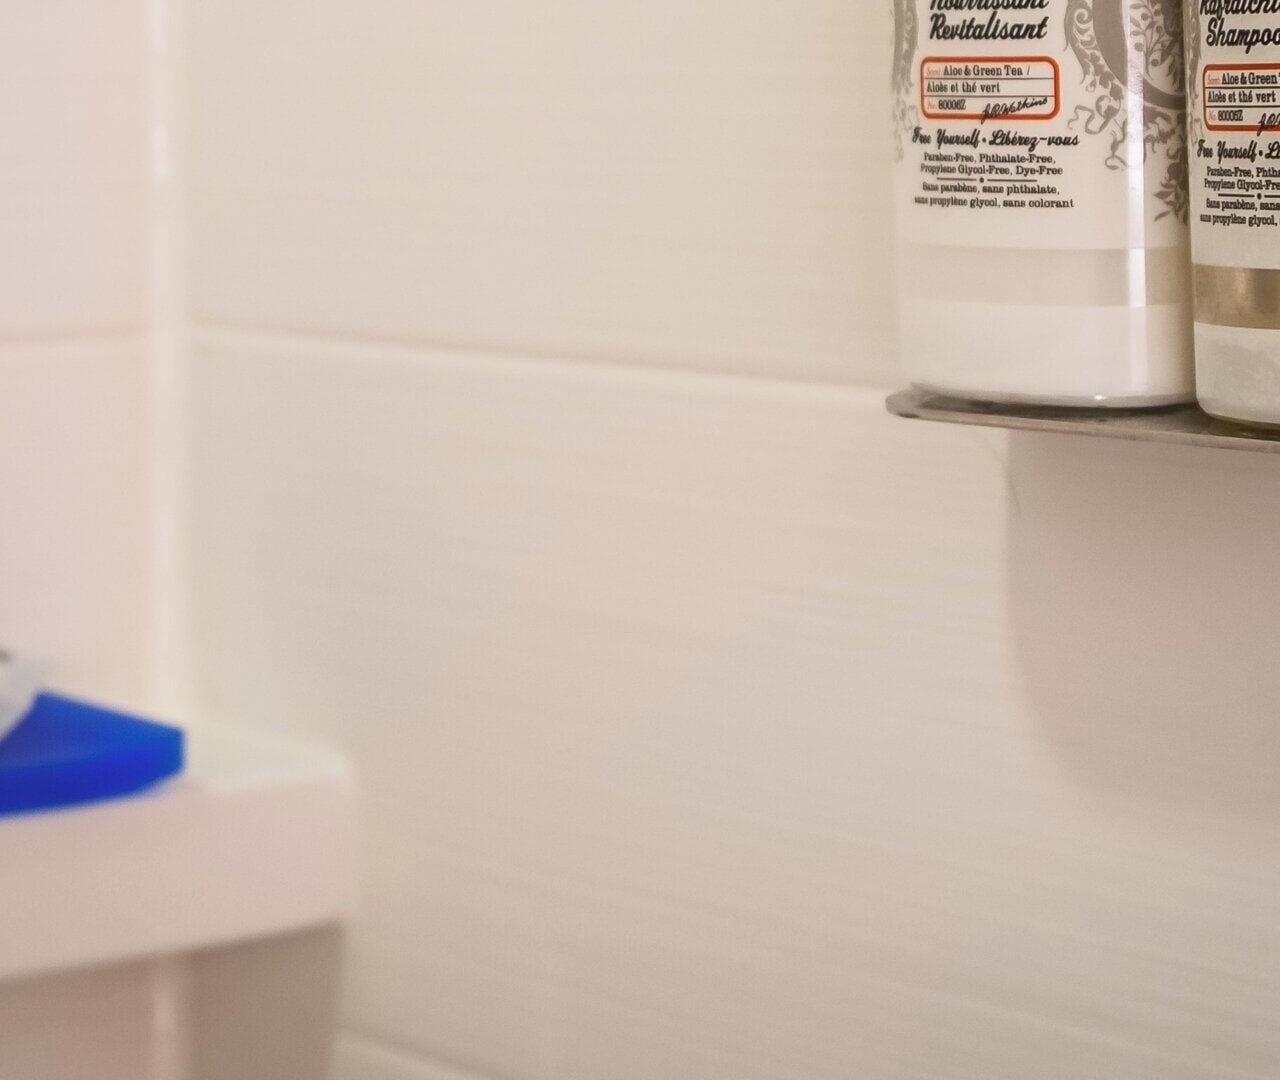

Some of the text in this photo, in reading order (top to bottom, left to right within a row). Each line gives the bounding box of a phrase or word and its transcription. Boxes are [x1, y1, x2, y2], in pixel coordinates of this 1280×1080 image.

[930, 11, 1049, 40] Revitalisant
[943, 65, 963, 76] Aloe
[964, 66, 971, 76] &
[973, 65, 1002, 76] Green
[1004, 65, 1023, 76] Tea
[1221, 73, 1239, 85] Aloe
[1240, 73, 1247, 85] &
[1248, 73, 1277, 85] Green
[927, 82, 1000, 93] Aloès et thé vert
[1208, 90, 1276, 103] Aloès et thé vert
[912, 126, 1080, 152] Free Yourself Libérez-vous
[923, 152, 1056, 164] Paraben-Free, Phthalate-Free,
[1197, 139, 1213, 159] Free
[1217, 140, 1258, 164] Yourself
[920, 164, 1064, 177] Propylene Glycol-Free, Dye-Free
[1207, 166, 1254, 178] Paraben-Free,
[922, 182, 1060, 196] Sans parabène, sans phthalate,
[1204, 178, 1235, 191] Propylene
[929, 196, 968, 207] propylène
[970, 197, 1001, 208] glycol,
[1028, 199, 1074, 208] colorant
[1221, 199, 1258, 211] parabène,
[1260, 202, 1280, 210] sans
[1212, 213, 1246, 225] propylène
[1248, 214, 1278, 227] glycol,
